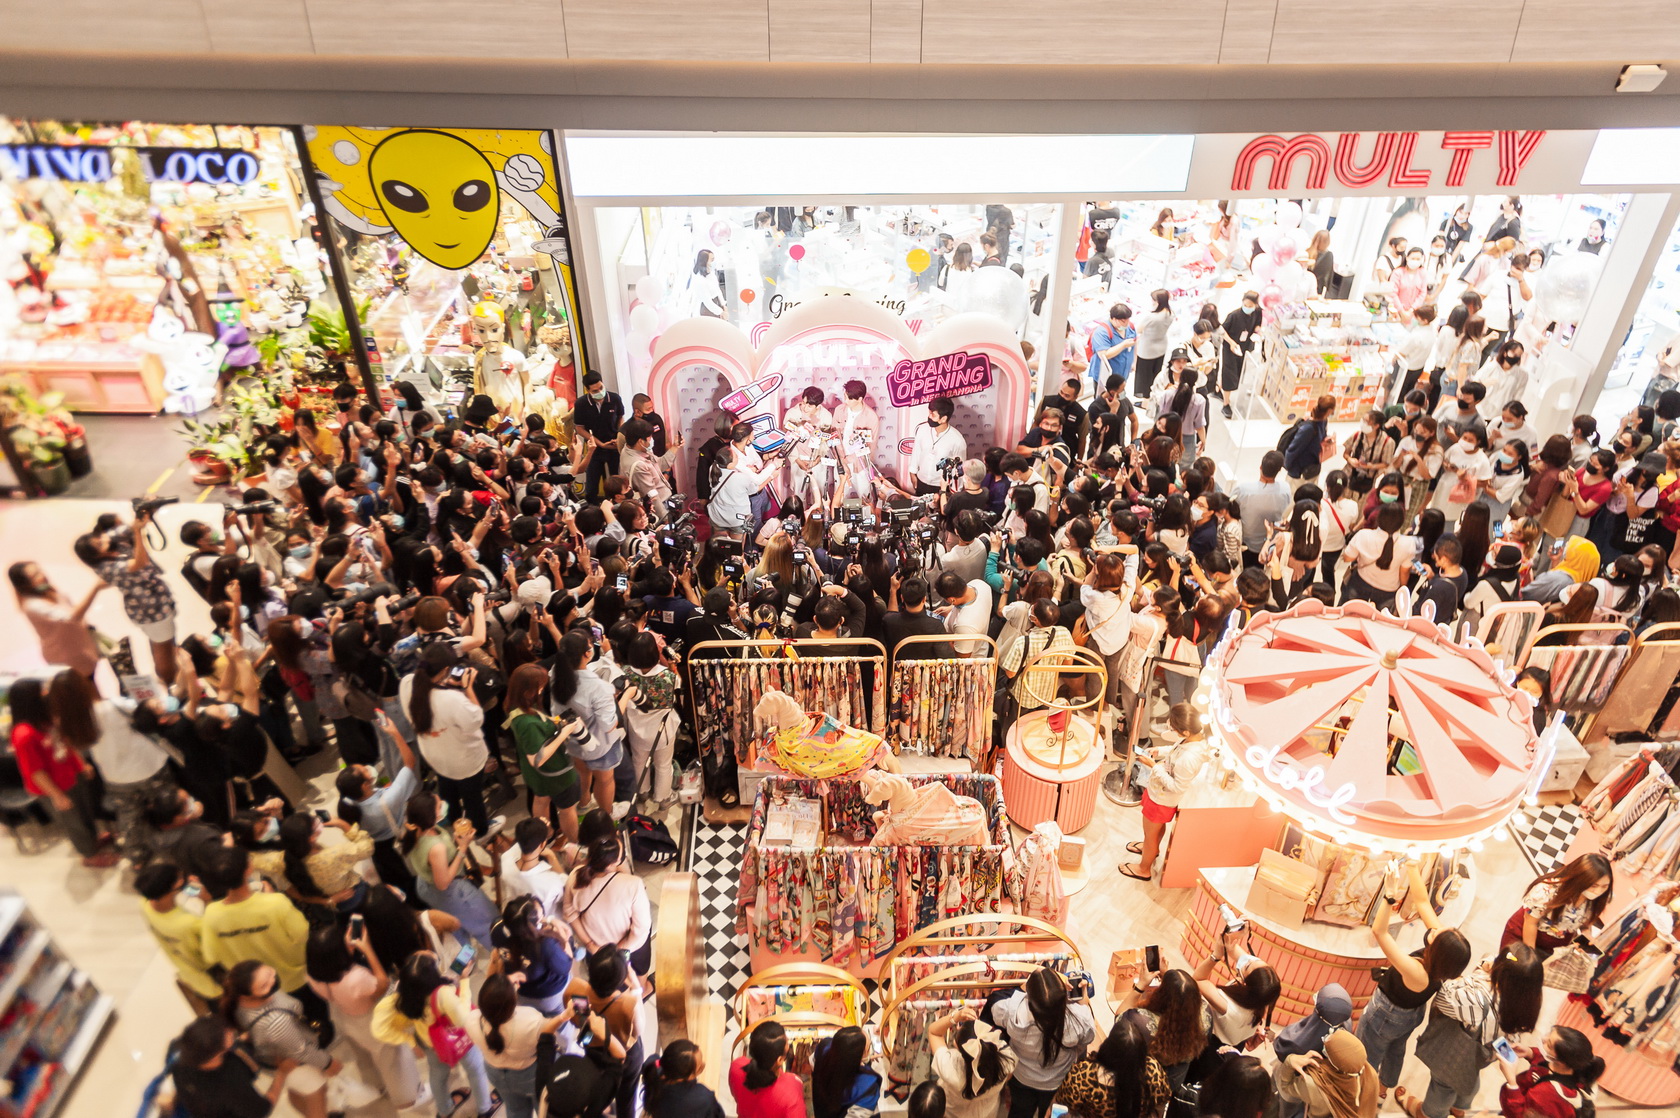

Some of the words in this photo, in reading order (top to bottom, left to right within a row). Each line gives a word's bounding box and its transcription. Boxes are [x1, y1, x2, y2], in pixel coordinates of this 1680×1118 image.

[140, 151, 257, 185] LOCO
[1231, 130, 1546, 190] MULTY
[770, 342, 899, 367] MULTY
[894, 352, 967, 383] GRAND
[897, 366, 985, 400] OPENING
